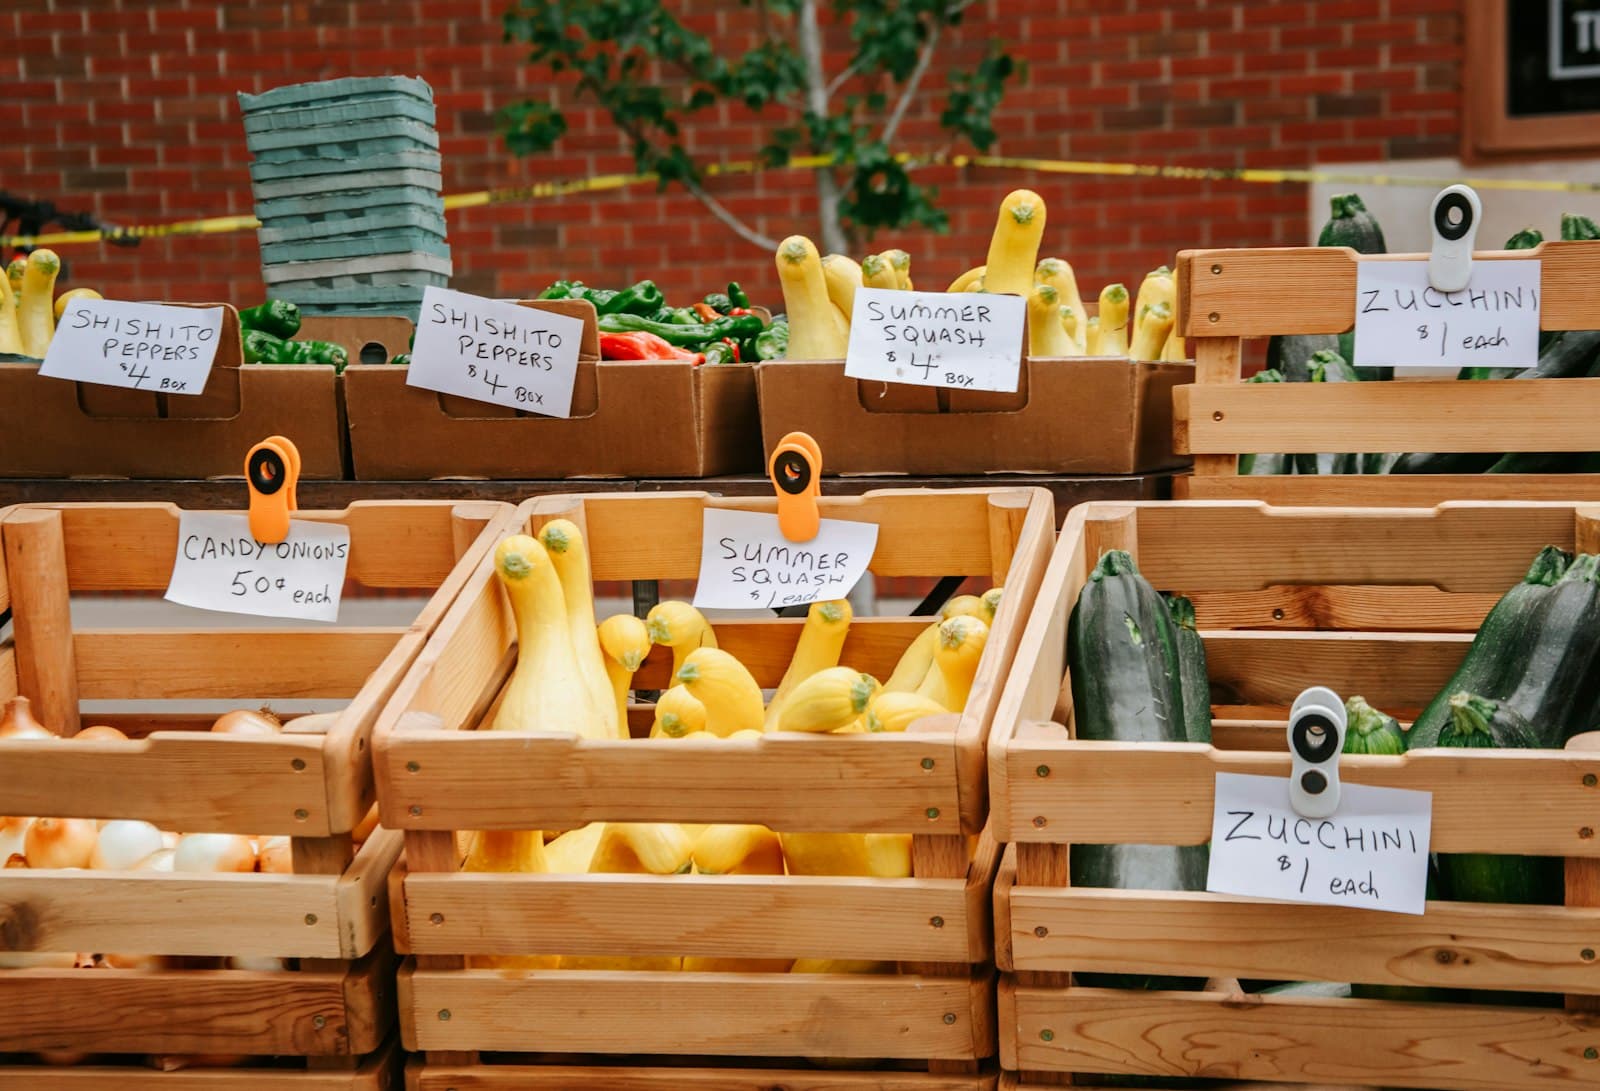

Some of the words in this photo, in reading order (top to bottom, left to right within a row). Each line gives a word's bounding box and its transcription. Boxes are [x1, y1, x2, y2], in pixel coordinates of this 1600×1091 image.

[868, 301, 991, 322] SUMMER
[1361, 286, 1537, 313] ZUCCHINI
[71, 309, 213, 341] SHISHITO
[431, 303, 562, 348] SHISHITO
[883, 325, 985, 347] SQUASH
[103, 338, 200, 360] PEPPERS
[459, 335, 553, 371] PEPPERS
[184, 535, 267, 561] CANDY
[275, 542, 348, 560] ONIONS
[719, 537, 849, 571] SUMMER
[231, 570, 286, 597] 50¢
[731, 566, 844, 587] SQUASH
[1225, 811, 1417, 853] ZUCCHINI
